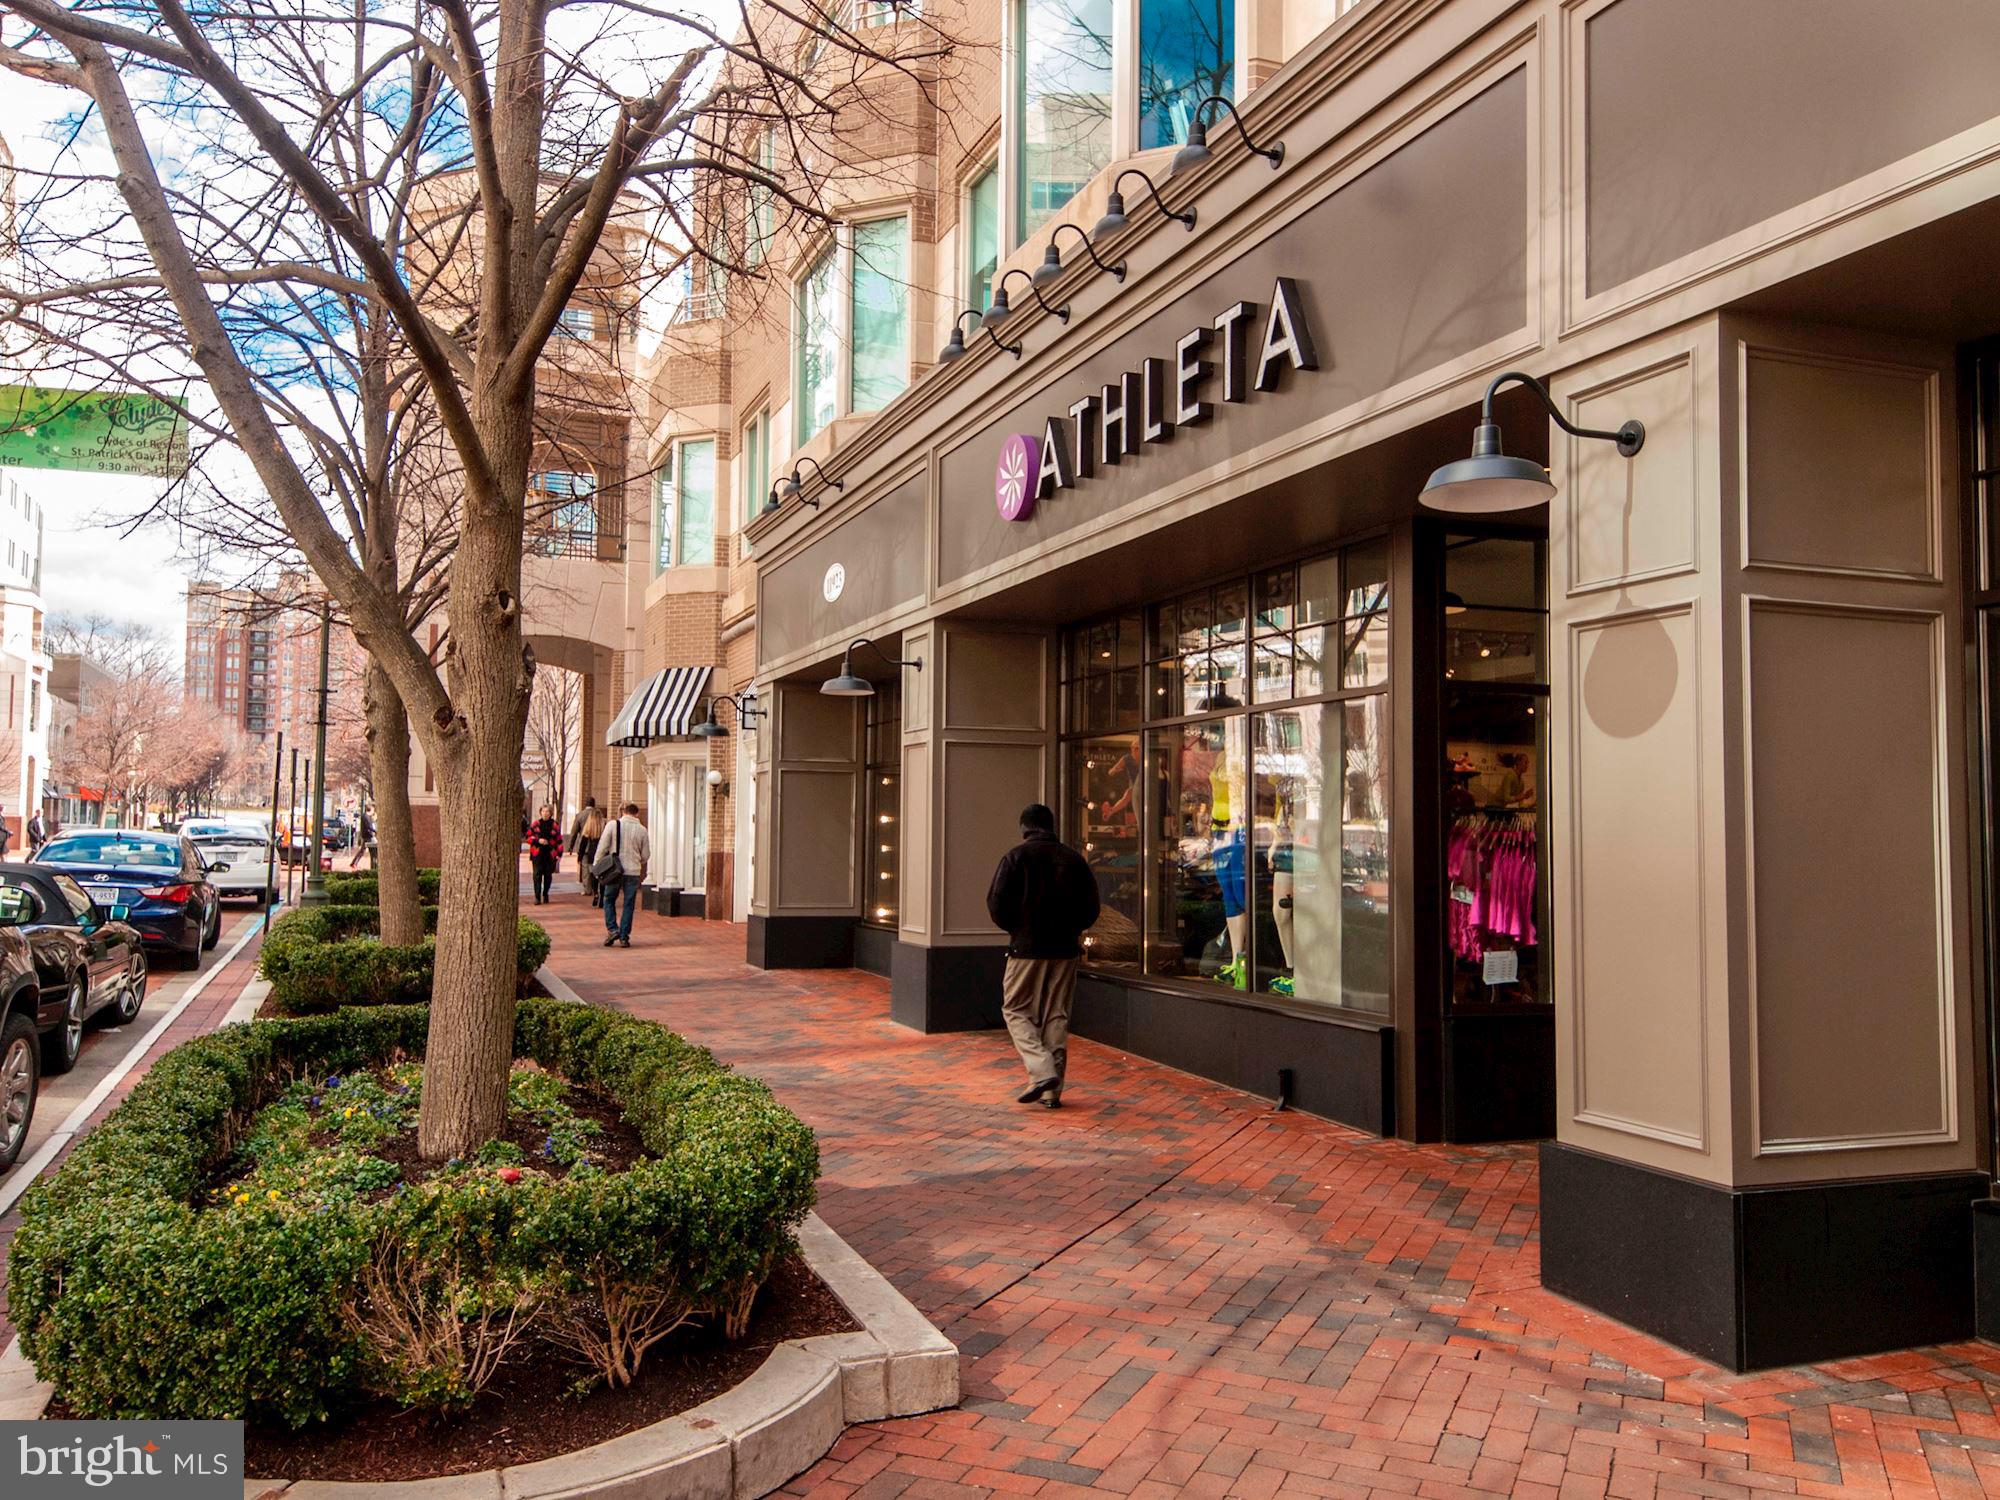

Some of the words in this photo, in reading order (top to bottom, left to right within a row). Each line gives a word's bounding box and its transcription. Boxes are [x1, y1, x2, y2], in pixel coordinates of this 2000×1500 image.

[1034, 277, 1318, 500] ATHLETA
[100, 399, 176, 435] Clydes
[96, 435, 133, 447] Clyde's
[136, 439, 147, 448] of
[150, 440, 185, 450] Reson
[0, 454, 24, 466] ter
[71, 447, 85, 457] St.
[135, 451, 155, 463] Day
[158, 452, 186, 464] Prty
[98, 461, 121, 472] 9:30
[124, 465, 141, 473] am
